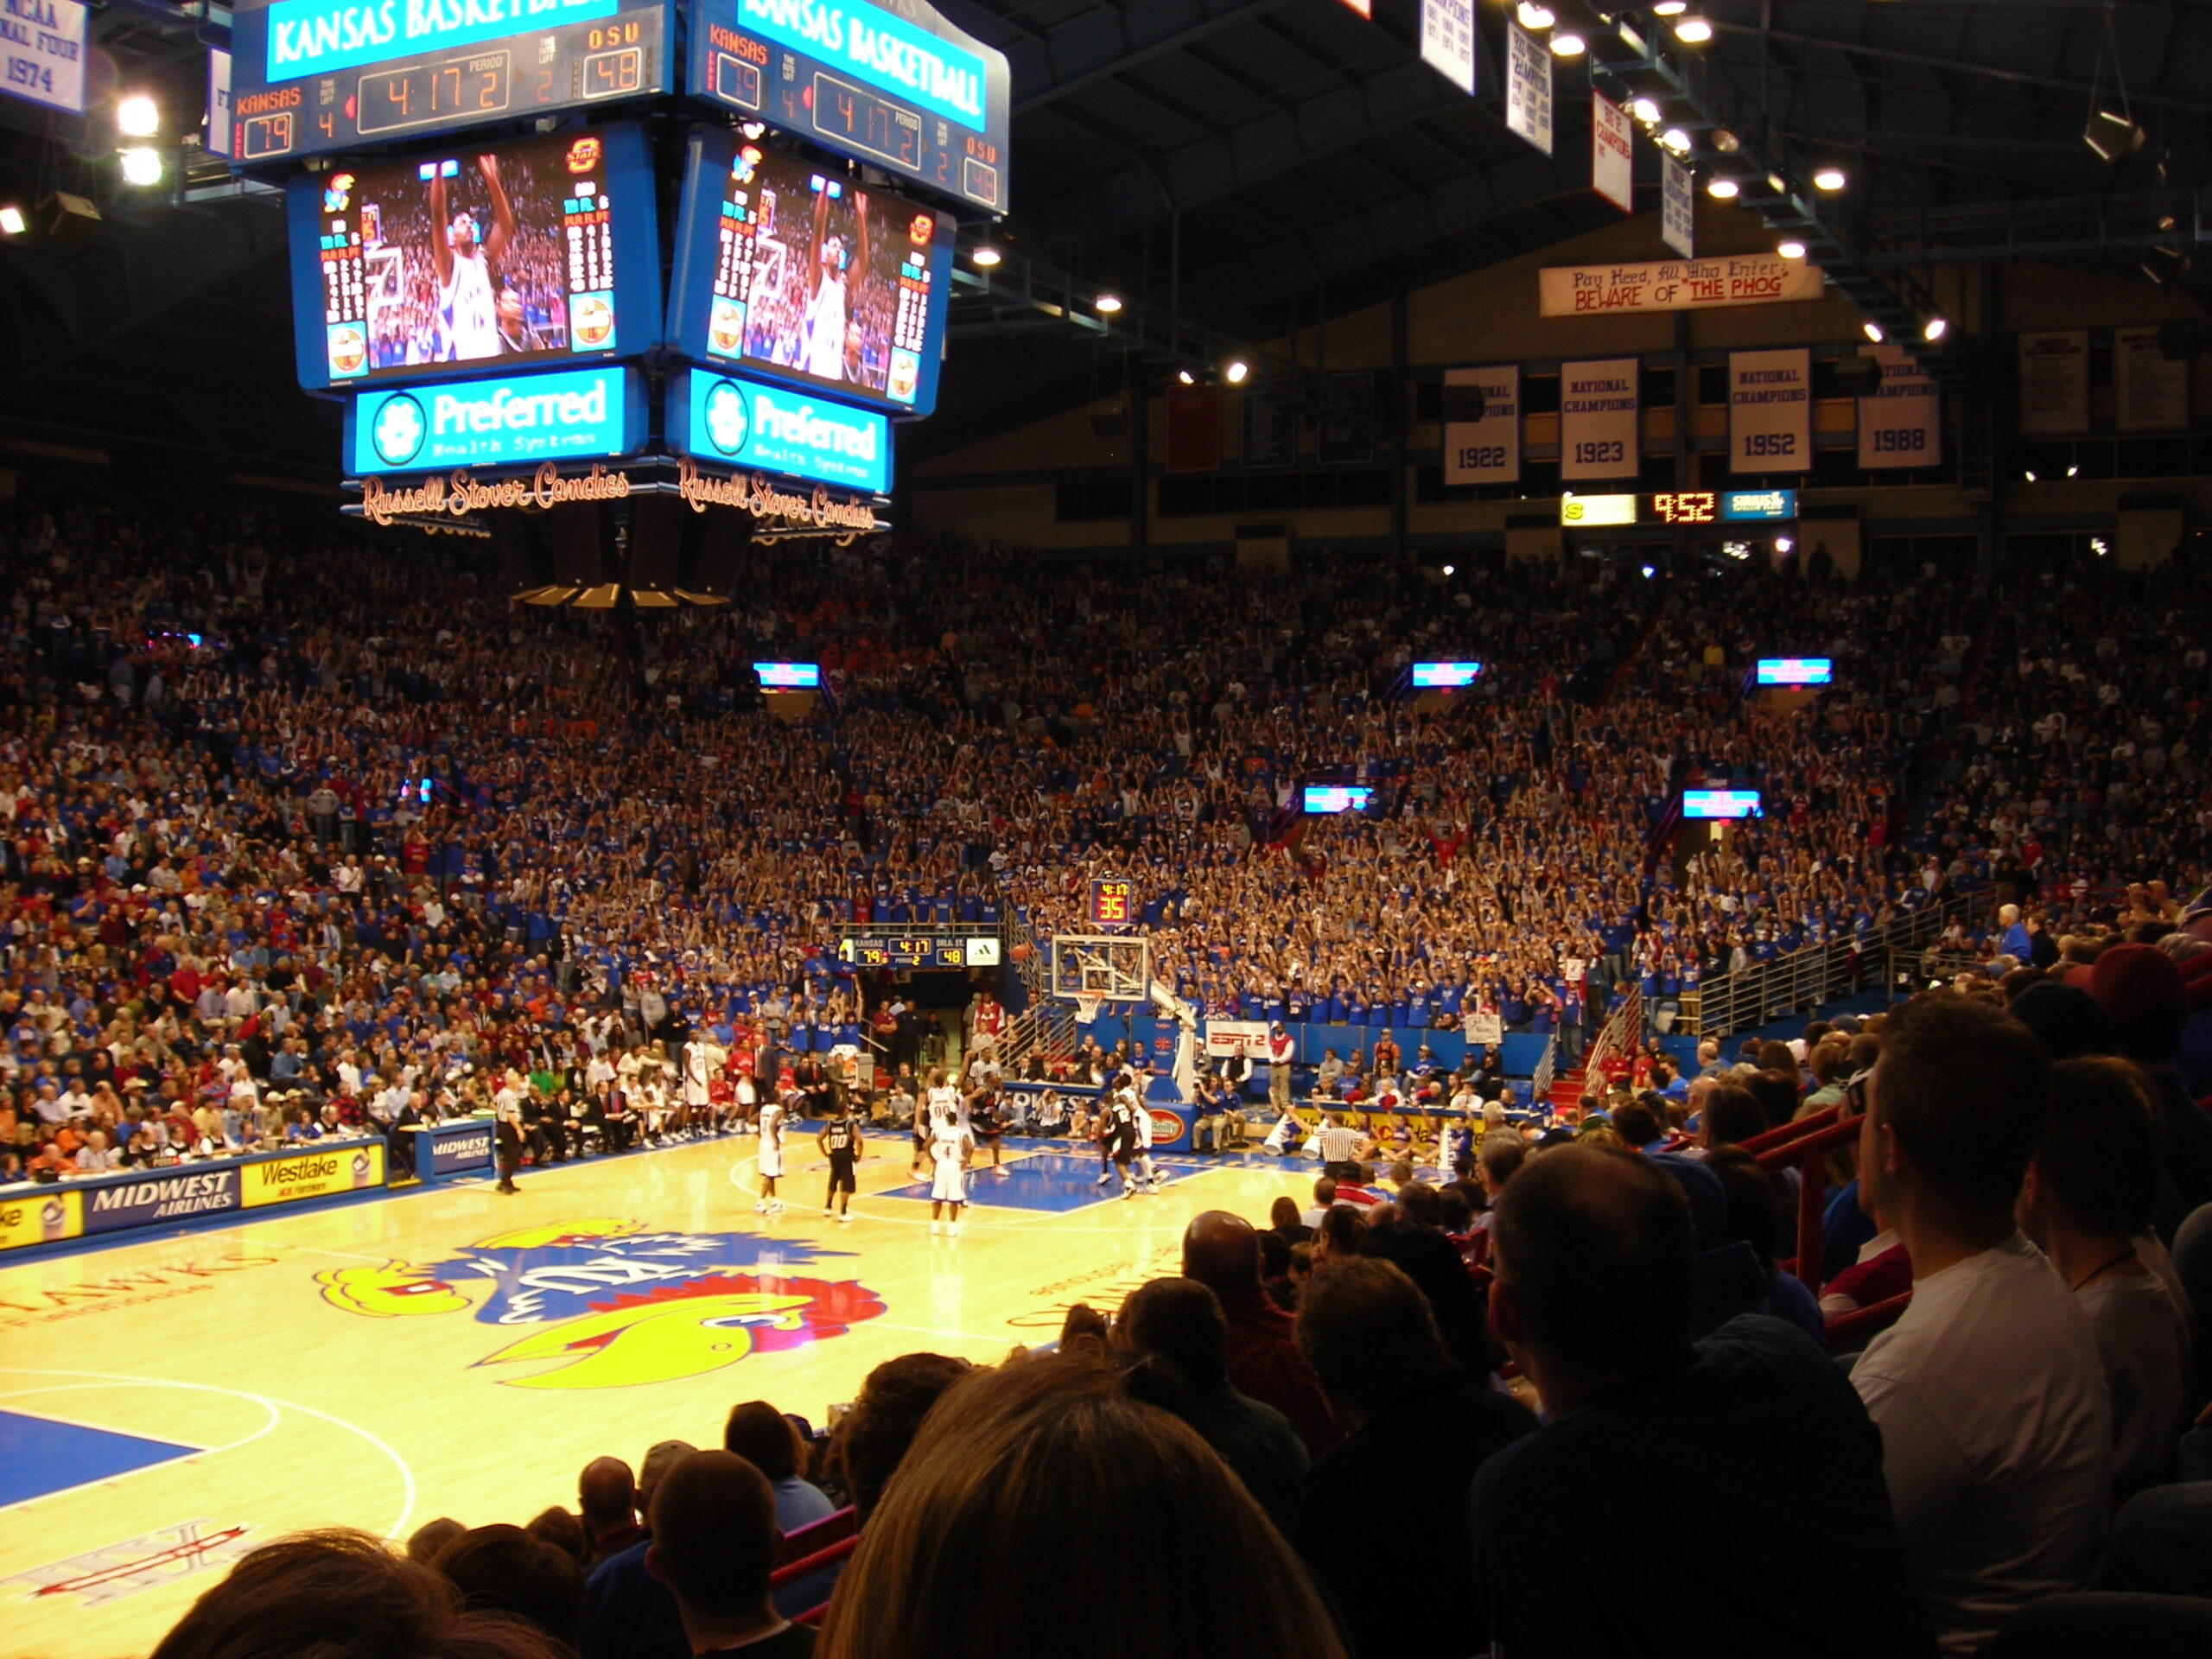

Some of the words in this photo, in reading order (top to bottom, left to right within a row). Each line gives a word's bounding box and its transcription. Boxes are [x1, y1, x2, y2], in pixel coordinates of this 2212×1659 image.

[275, 1, 397, 64] KANSAS
[589, 22, 639, 50] OSU
[709, 24, 768, 66] KANSAS
[36, 31, 79, 61] FOUR
[7, 54, 53, 93] 1974
[469, 55, 503, 73] PERIOD
[598, 52, 637, 88] 48
[849, 16, 982, 117] BASKETBALL
[237, 87, 302, 116] KANSAS
[480, 72, 498, 108] 2
[258, 116, 289, 149] 79
[320, 112, 333, 138] 4
[895, 111, 918, 130] PERIOD
[900, 130, 912, 163] 2
[966, 137, 996, 163] OSU
[938, 152, 947, 181] 2
[1575, 285, 1643, 311] BEWARE
[1655, 285, 1679, 302] OF
[1571, 379, 1629, 394] NATIONAL
[1739, 370, 1800, 385] NATIONAL
[435, 378, 606, 435] Preferred
[1564, 397, 1636, 413] CHAMPIONS
[1732, 389, 1807, 404] CHAMPIONS
[754, 395, 876, 461] Preferred
[1873, 429, 1925, 451] 1988
[1575, 442, 1623, 463] 1923
[1745, 433, 1796, 456] 1952
[1458, 447, 1505, 470] 1922
[359, 475, 445, 525] Russell
[448, 468, 530, 516] Stover
[534, 461, 629, 509] Candies
[677, 457, 748, 513] Russell
[749, 472, 811, 521] Stover
[812, 483, 874, 529] Candies
[1101, 898, 1123, 919] 35
[864, 950, 880, 963] 79
[912, 956, 920, 965] 2
[944, 950, 961, 963] 48
[432, 1136, 490, 1156] MIDWEST
[944, 1146, 950, 1159] 4
[263, 1158, 337, 1185] Westlake
[92, 1170, 233, 1212] MIDWEST
[152, 1192, 233, 1219] AIRLINES
